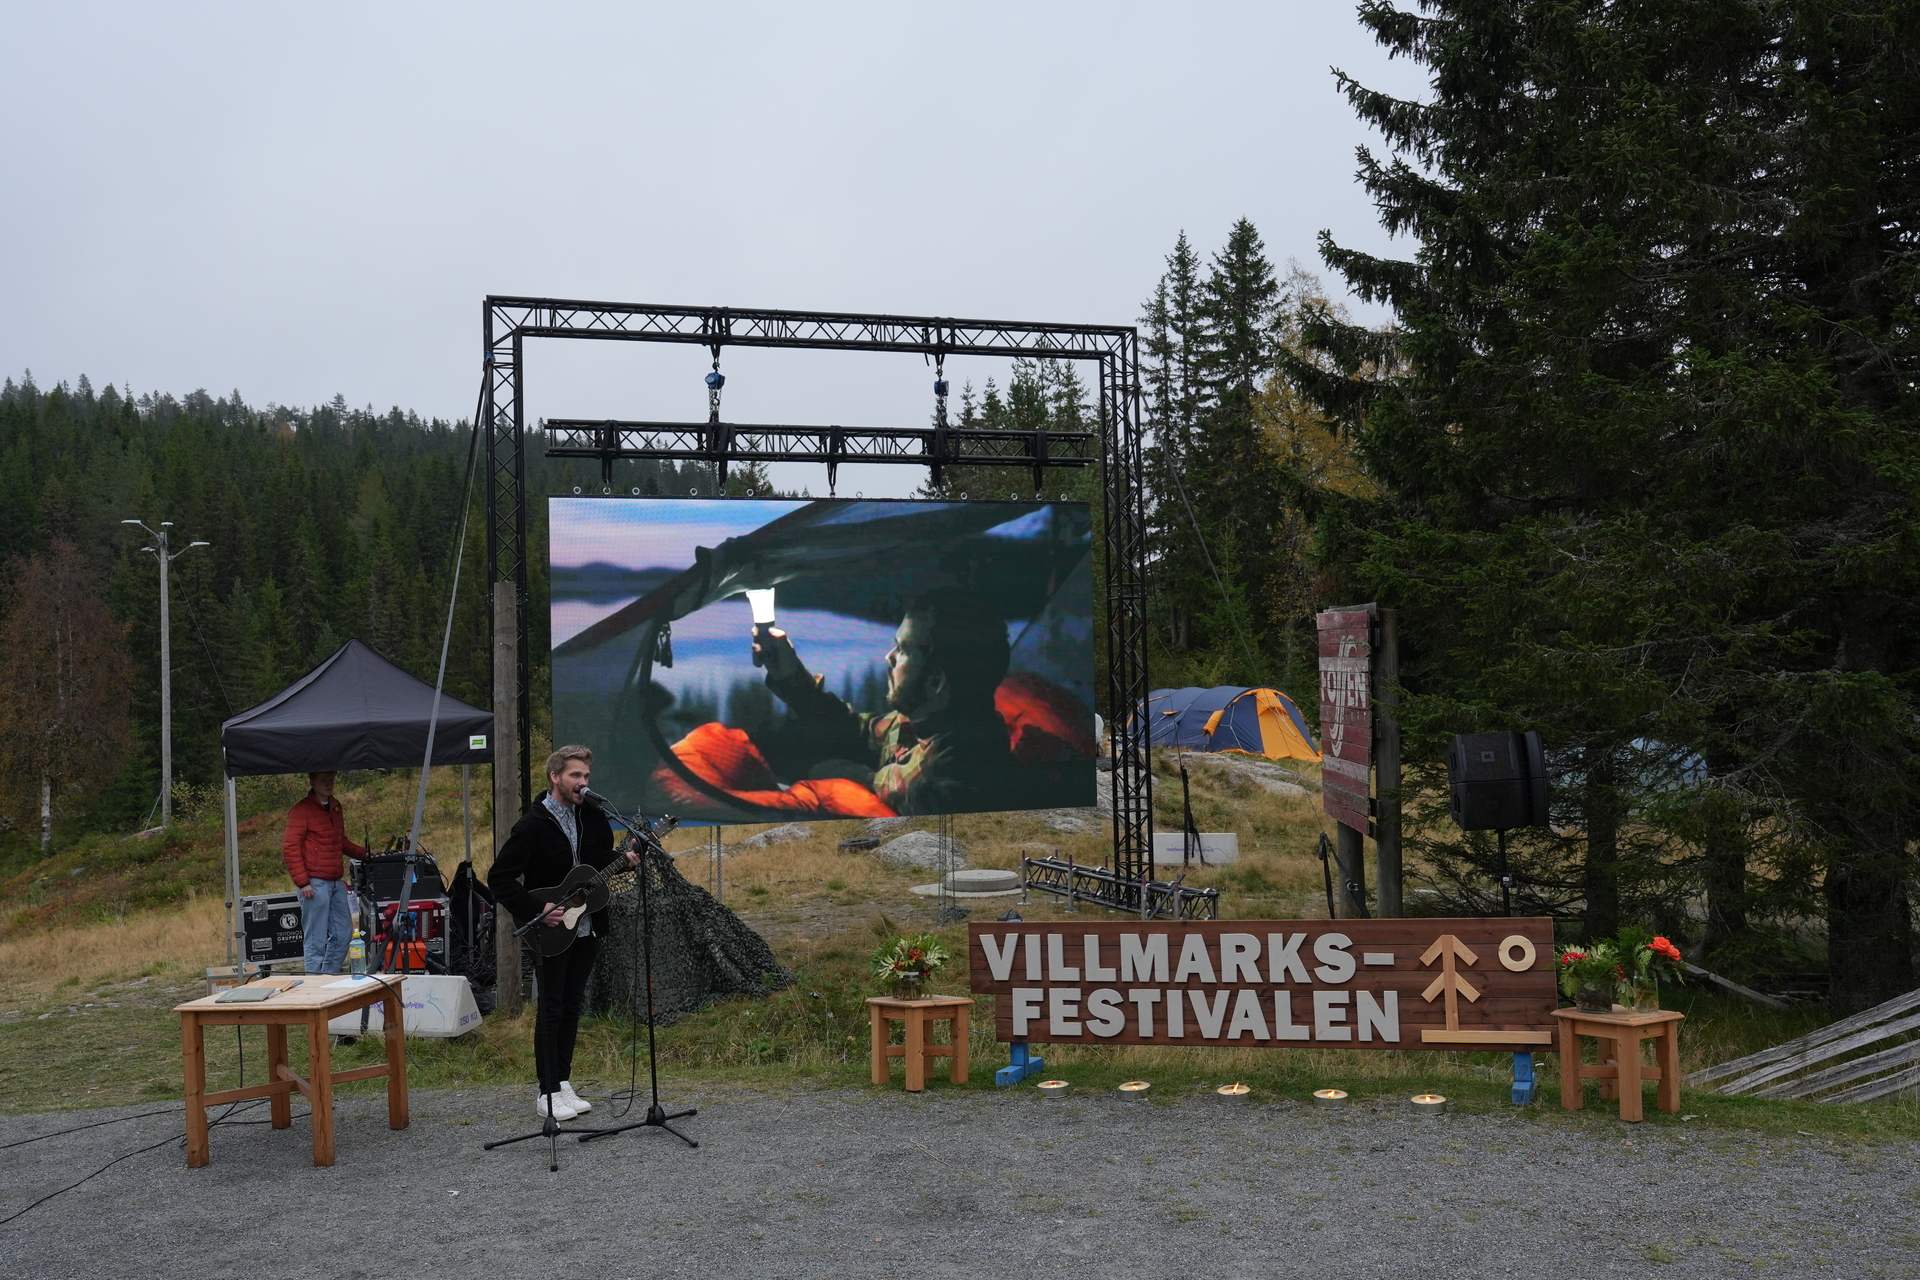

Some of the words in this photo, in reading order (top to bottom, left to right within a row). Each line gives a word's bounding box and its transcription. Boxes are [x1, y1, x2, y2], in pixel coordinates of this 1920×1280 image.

[978, 933, 1395, 984] VILLMARKS-
[460, 1015, 470, 1026] 250
[471, 1011, 478, 1021] KG
[1011, 987, 1400, 1042] FESTIVALEN
